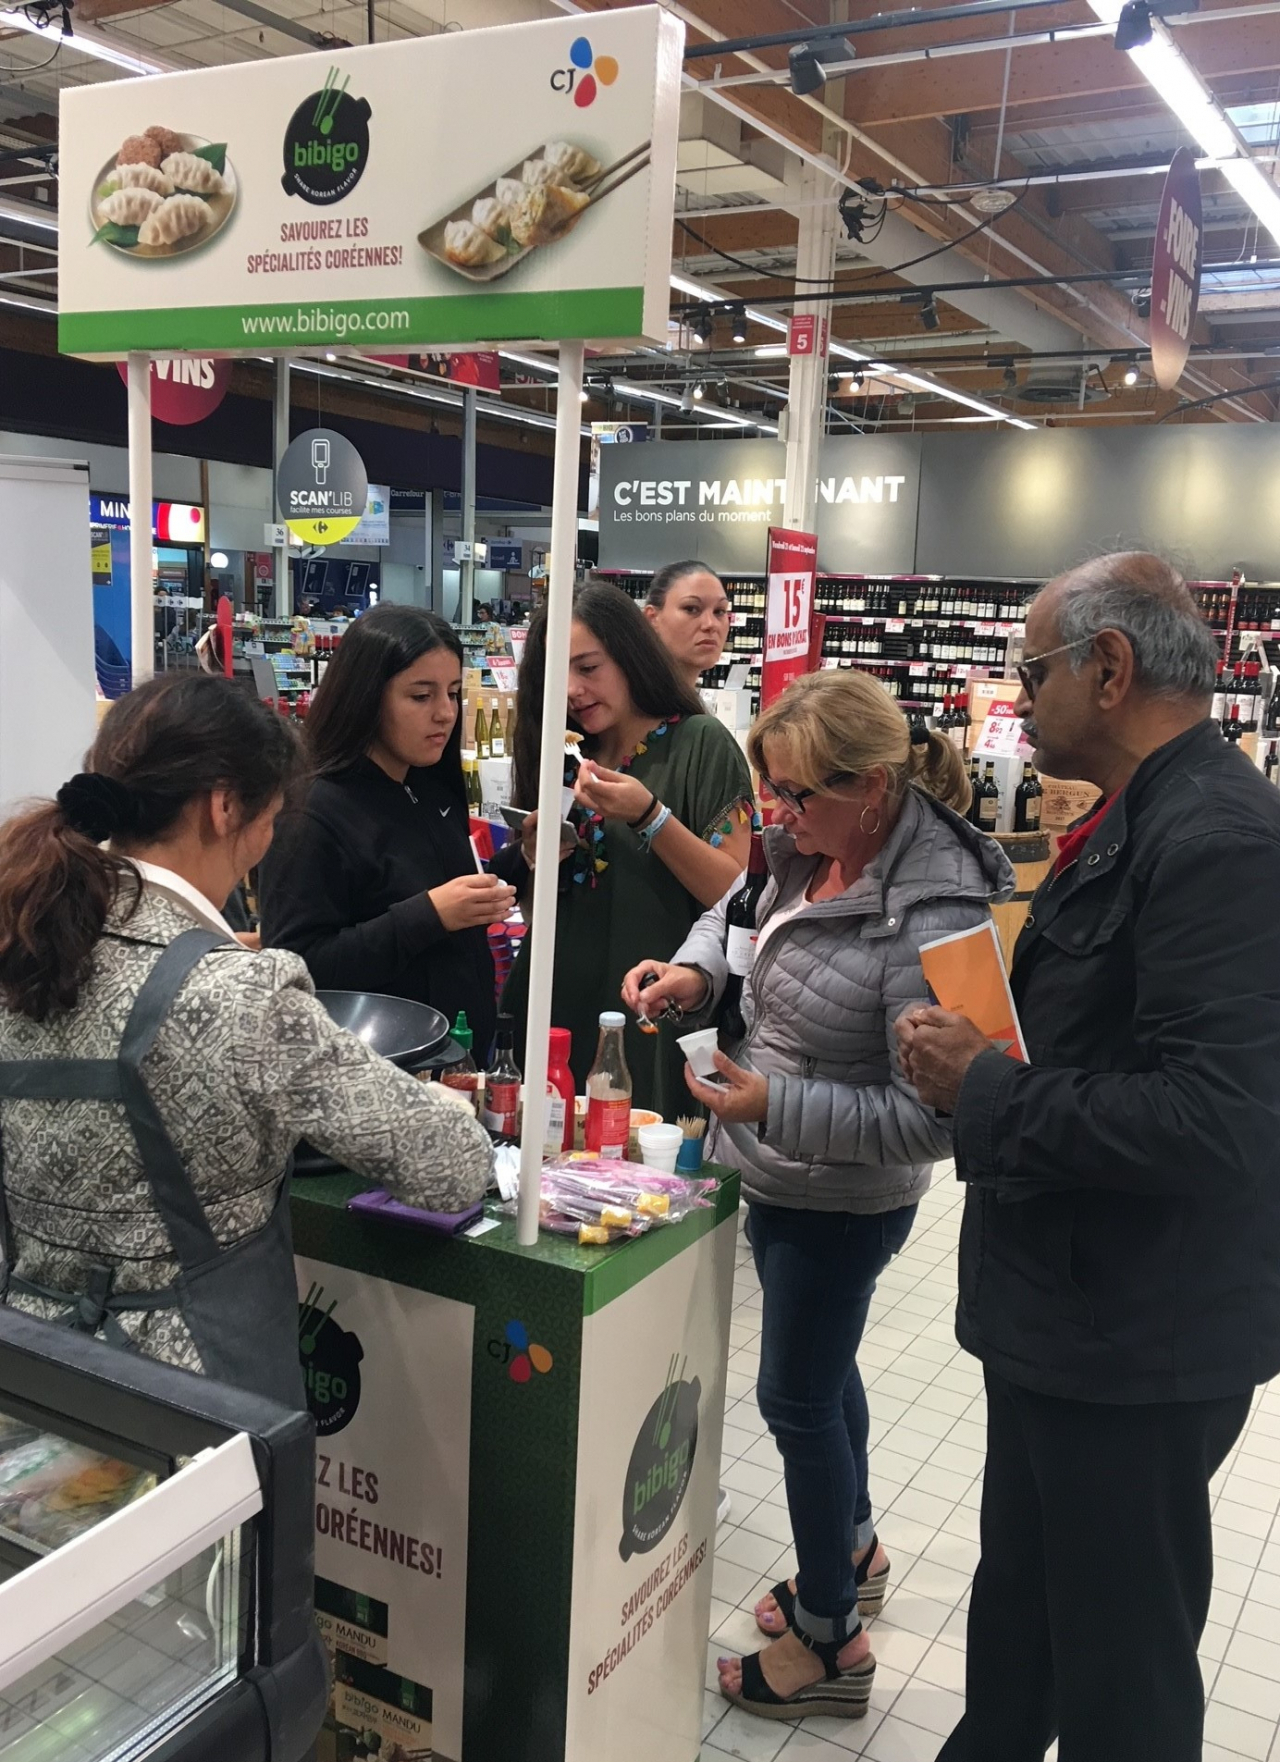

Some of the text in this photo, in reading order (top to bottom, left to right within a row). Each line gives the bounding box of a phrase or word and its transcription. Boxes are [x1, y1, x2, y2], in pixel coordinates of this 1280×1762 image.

[550, 68, 576, 94] CJ
[294, 138, 358, 172] bibigo
[294, 168, 358, 198] SHARE KOREAN FLAVOR
[280, 216, 368, 242] SAVOUREZ LES
[1166, 196, 1199, 280] FOIRE
[247, 243, 402, 274] SPÉCIALITÉS CORÉENNES!
[1166, 268, 1192, 340] VINS
[242, 308, 409, 337] www.bibigo.com
[796, 334, 808, 350] 5
[155, 358, 215, 390] VINS
[290, 490, 352, 506] SCAN'LIB
[390, 490, 424, 498] Carrefour
[614, 480, 691, 506] C'EST
[290, 506, 310, 514] facilite
[614, 509, 772, 524] Les bons plans du moment
[768, 634, 776, 650] EN
[487, 1338, 512, 1364] CJ
[339, 1462, 378, 1504] LES
[633, 1438, 690, 1515] bibigo
[632, 1524, 647, 1542] SHARE
[620, 1532, 688, 1626] SAVOUREZ LES
[588, 1538, 708, 1695] SPÉCIALITÉS CORÉENNES!
[336, 1623, 376, 1648] MANDU
[344, 1692, 379, 1714] bibigo
[382, 1709, 421, 1734] MANDU
